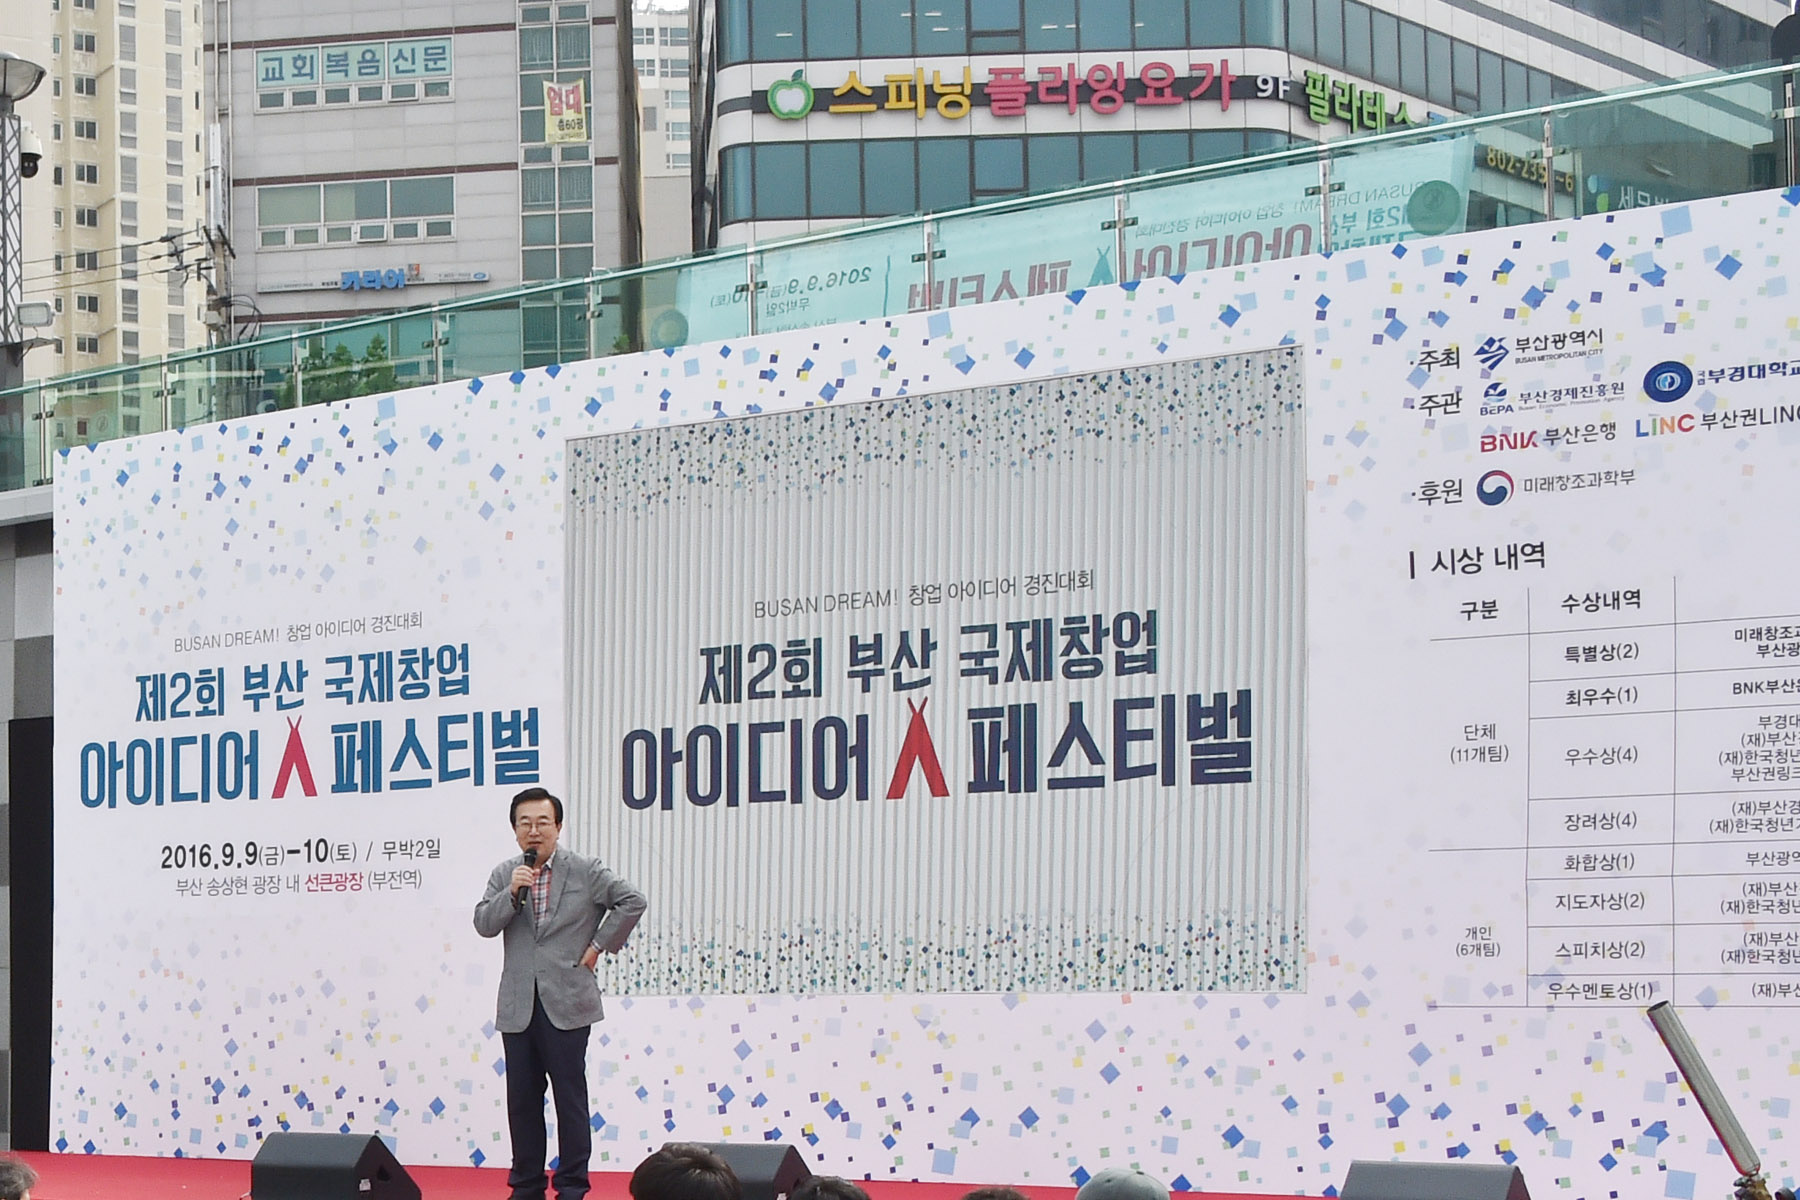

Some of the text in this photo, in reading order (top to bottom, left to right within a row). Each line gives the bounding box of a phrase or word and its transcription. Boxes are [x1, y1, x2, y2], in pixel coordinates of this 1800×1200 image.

[261, 45, 448, 82] 교회복음신문
[546, 84, 582, 116] 임대
[828, 59, 1291, 119] 스피닝 플라잉요가 9F
[1515, 328, 1604, 353] 부산광역시
[1418, 346, 1461, 373] 주최
[1515, 348, 1604, 364] BUSAN METROPOLITAN CITY
[1418, 391, 1463, 417] 주관
[1519, 381, 1625, 404] 부산경제진흥원
[1635, 413, 1696, 438] LINC
[1701, 404, 1800, 432] 부산권LIN
[1481, 421, 1617, 453] BNK 부산은행
[1417, 479, 1463, 506] 후원
[1523, 469, 1636, 493] 미래창조과학부
[1431, 541, 1546, 576] 시상 내역
[754, 568, 1094, 618] BUSAN DREAM! 창업 아이디어 경진대회
[1561, 589, 1642, 614] 수상내역
[1460, 600, 1500, 621] 구분
[174, 611, 423, 653] BUSAN DREAM! 창업 아이디어 경진대회
[699, 608, 1159, 705] 제2회 부산 국제창업
[1564, 641, 1640, 664] 특별상(2)
[135, 643, 470, 723] 제2회 부산 국제창업
[1565, 685, 1639, 709] 최우수(1)
[1464, 723, 1497, 742] 단체
[1741, 731, 1800, 748] (재)부산
[80, 706, 541, 810] 아이디어 페스티벌
[621, 688, 1253, 812] 아이디어 페스티벌
[1450, 744, 1510, 766] (11개팀)
[1564, 747, 1639, 769] 우수상(4)
[1563, 811, 1639, 833] 장려상(4)
[381, 838, 442, 862] 무박2일
[1564, 852, 1636, 874] 화합상(1)
[176, 869, 423, 897] 부산 송상현 광장 내 선큰광장 (부전역)
[1742, 881, 1800, 897] (재)부산
[1555, 891, 1646, 914] 지도자상(2)
[1464, 926, 1493, 942] 개인
[1455, 942, 1501, 960] (6개팀)
[1555, 941, 1646, 962] 스피치상(2)
[1547, 981, 1653, 1003] 우수멘토상(1)
